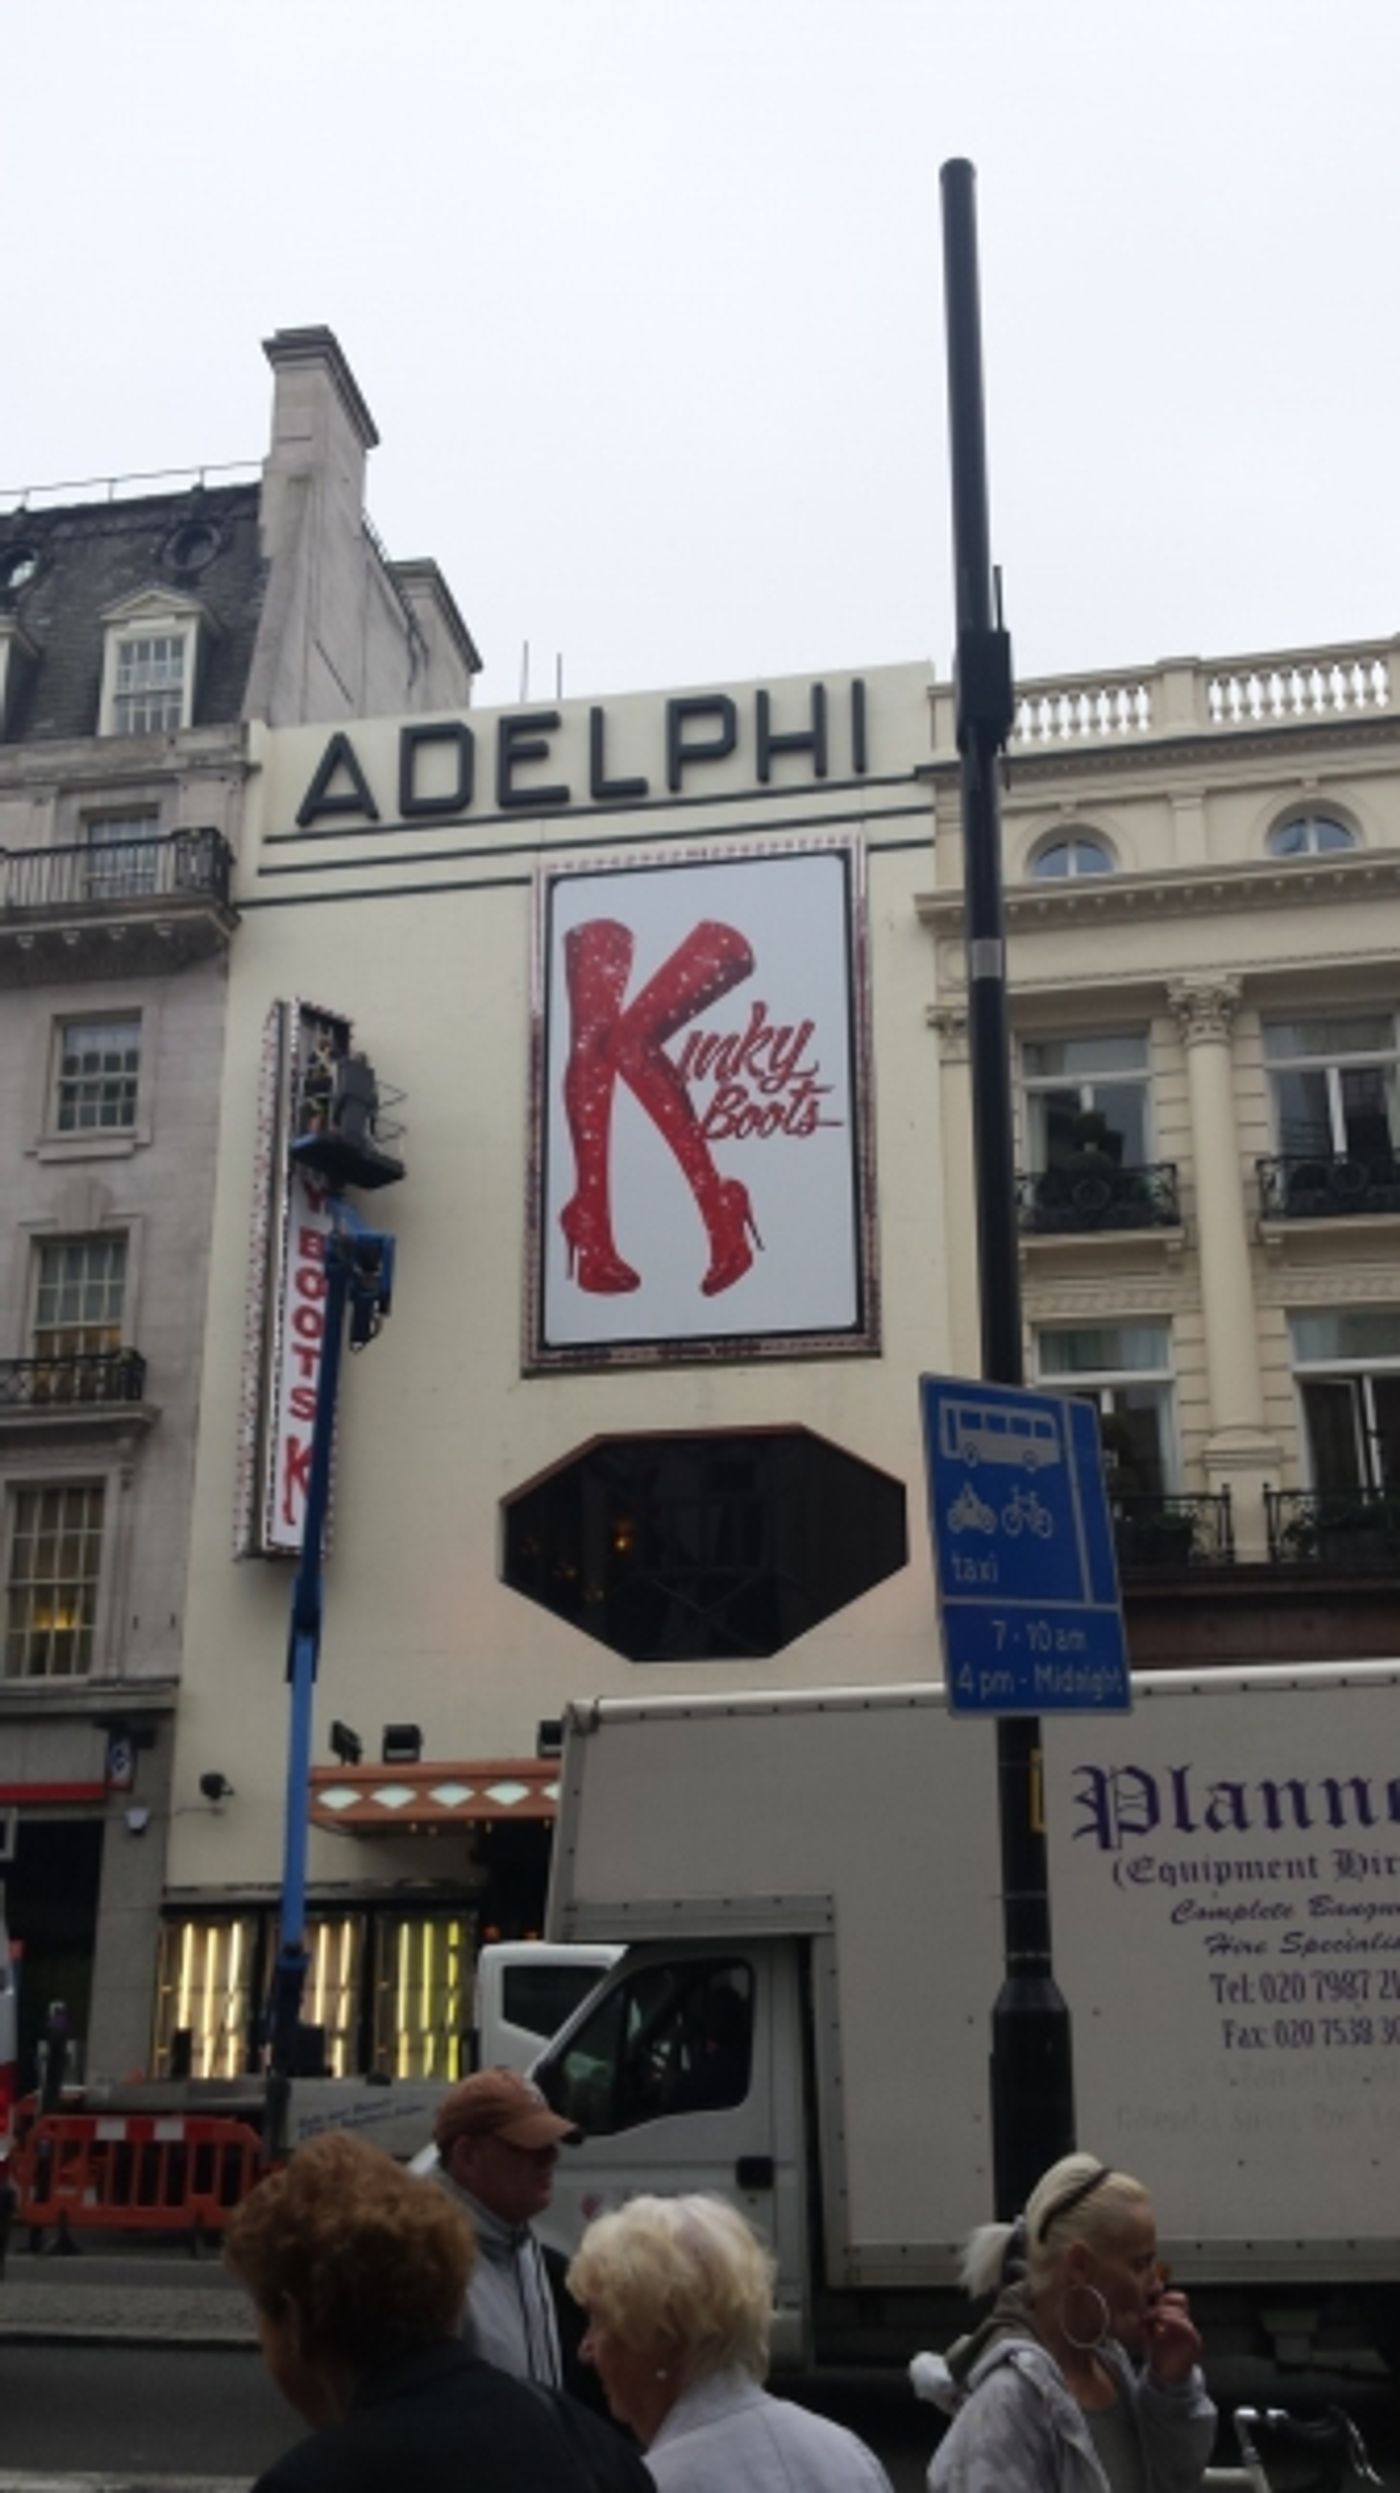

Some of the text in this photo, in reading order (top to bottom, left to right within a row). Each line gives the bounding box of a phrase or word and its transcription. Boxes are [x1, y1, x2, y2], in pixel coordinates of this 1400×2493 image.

[295, 678, 866, 827] ADELPHI
[560, 918, 818, 1297] Kinky
[703, 1079, 844, 1139] Boots
[290, 1227, 328, 1421] BOOTS
[952, 1551, 999, 1583] taxi
[991, 1619, 1007, 1652] 7
[1034, 1662, 1123, 1701] Midnight
[1170, 1893, 1400, 1924] Complete Banqu
[1204, 1931, 1267, 1957] Hire
[1260, 1970, 1306, 2003] 020
[1273, 2018, 1315, 2049] 020
